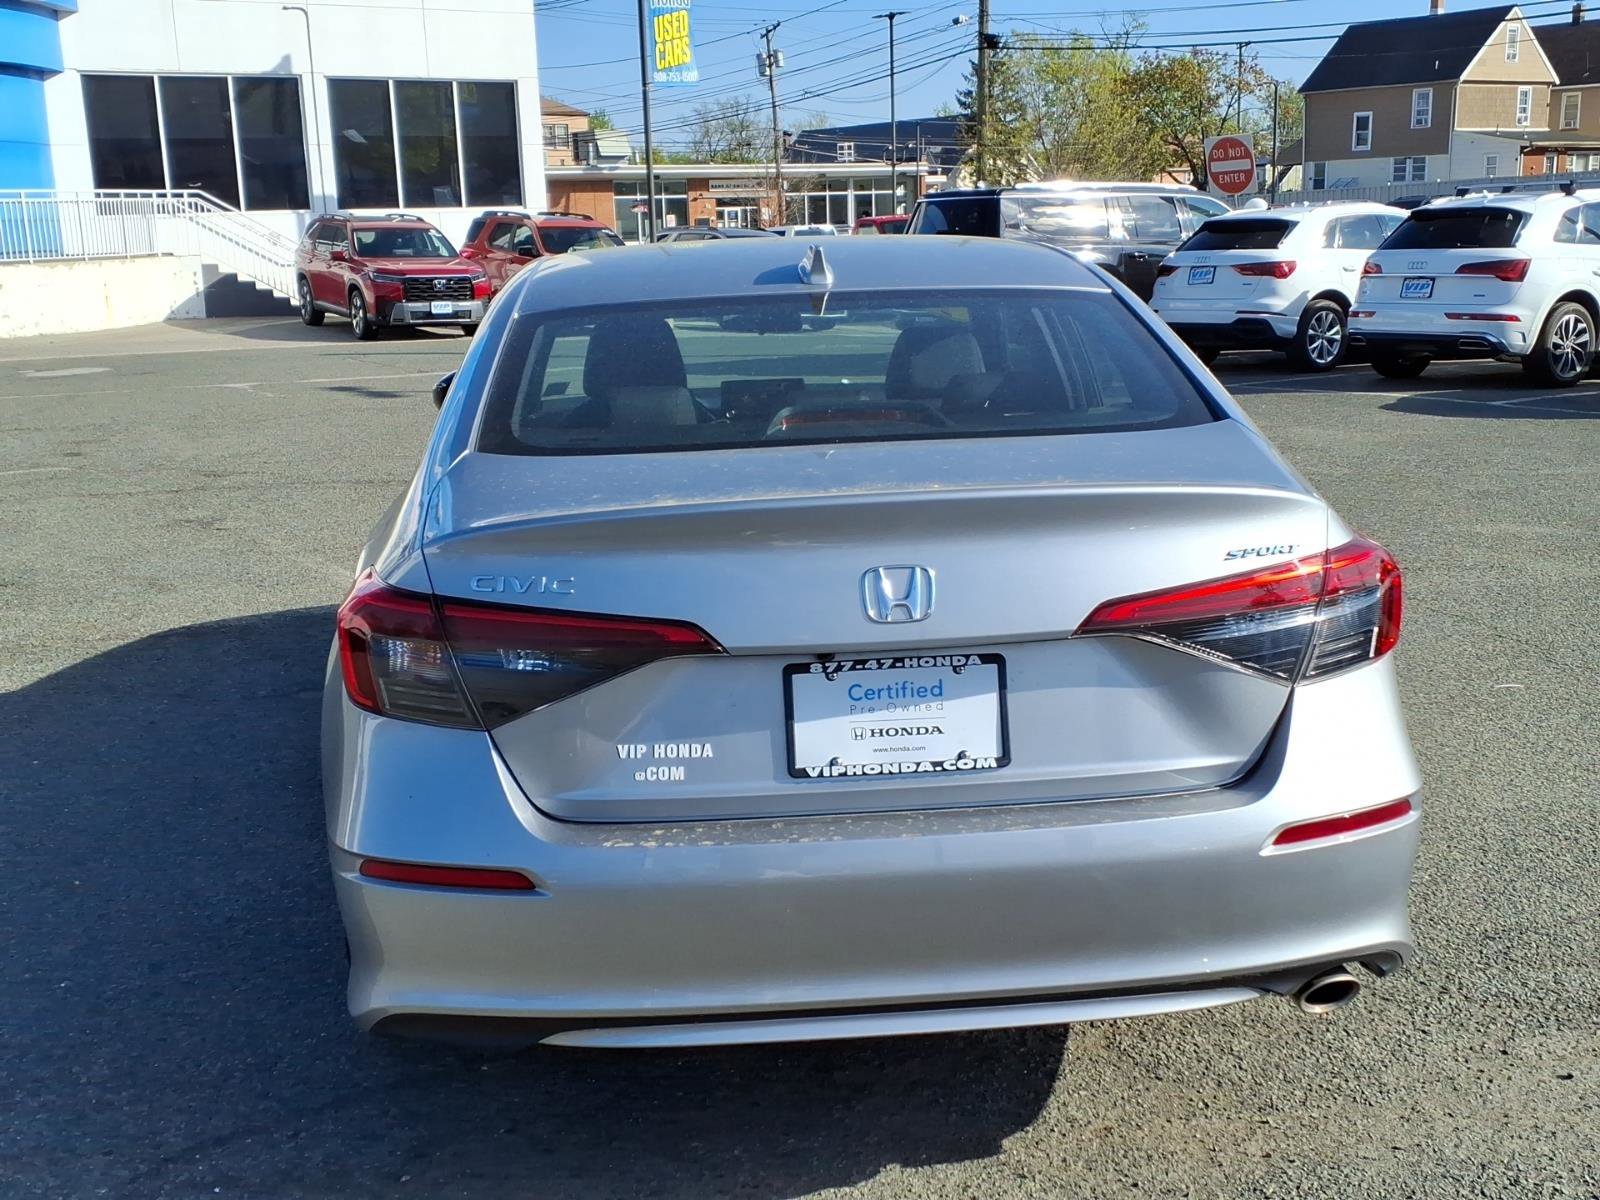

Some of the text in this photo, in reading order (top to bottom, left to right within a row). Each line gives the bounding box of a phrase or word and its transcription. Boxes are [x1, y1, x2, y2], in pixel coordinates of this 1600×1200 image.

[654, 10, 688, 43] USED
[656, 36, 691, 70] CARS
[1212, 147, 1246, 159] DO NOT
[1219, 173, 1246, 184] ENTER
[1404, 282, 1430, 291] VIP
[1223, 544, 1301, 561] SPORT
[470, 575, 576, 594] CIVIC
[809, 655, 982, 674] 877-47-HONDA
[848, 679, 944, 702] Certified
[869, 725, 944, 738] HONDA
[616, 743, 714, 759] VIP HONDA
[872, 744, 926, 754] www.honda.com
[805, 757, 997, 778] VIPHONDA.COM
